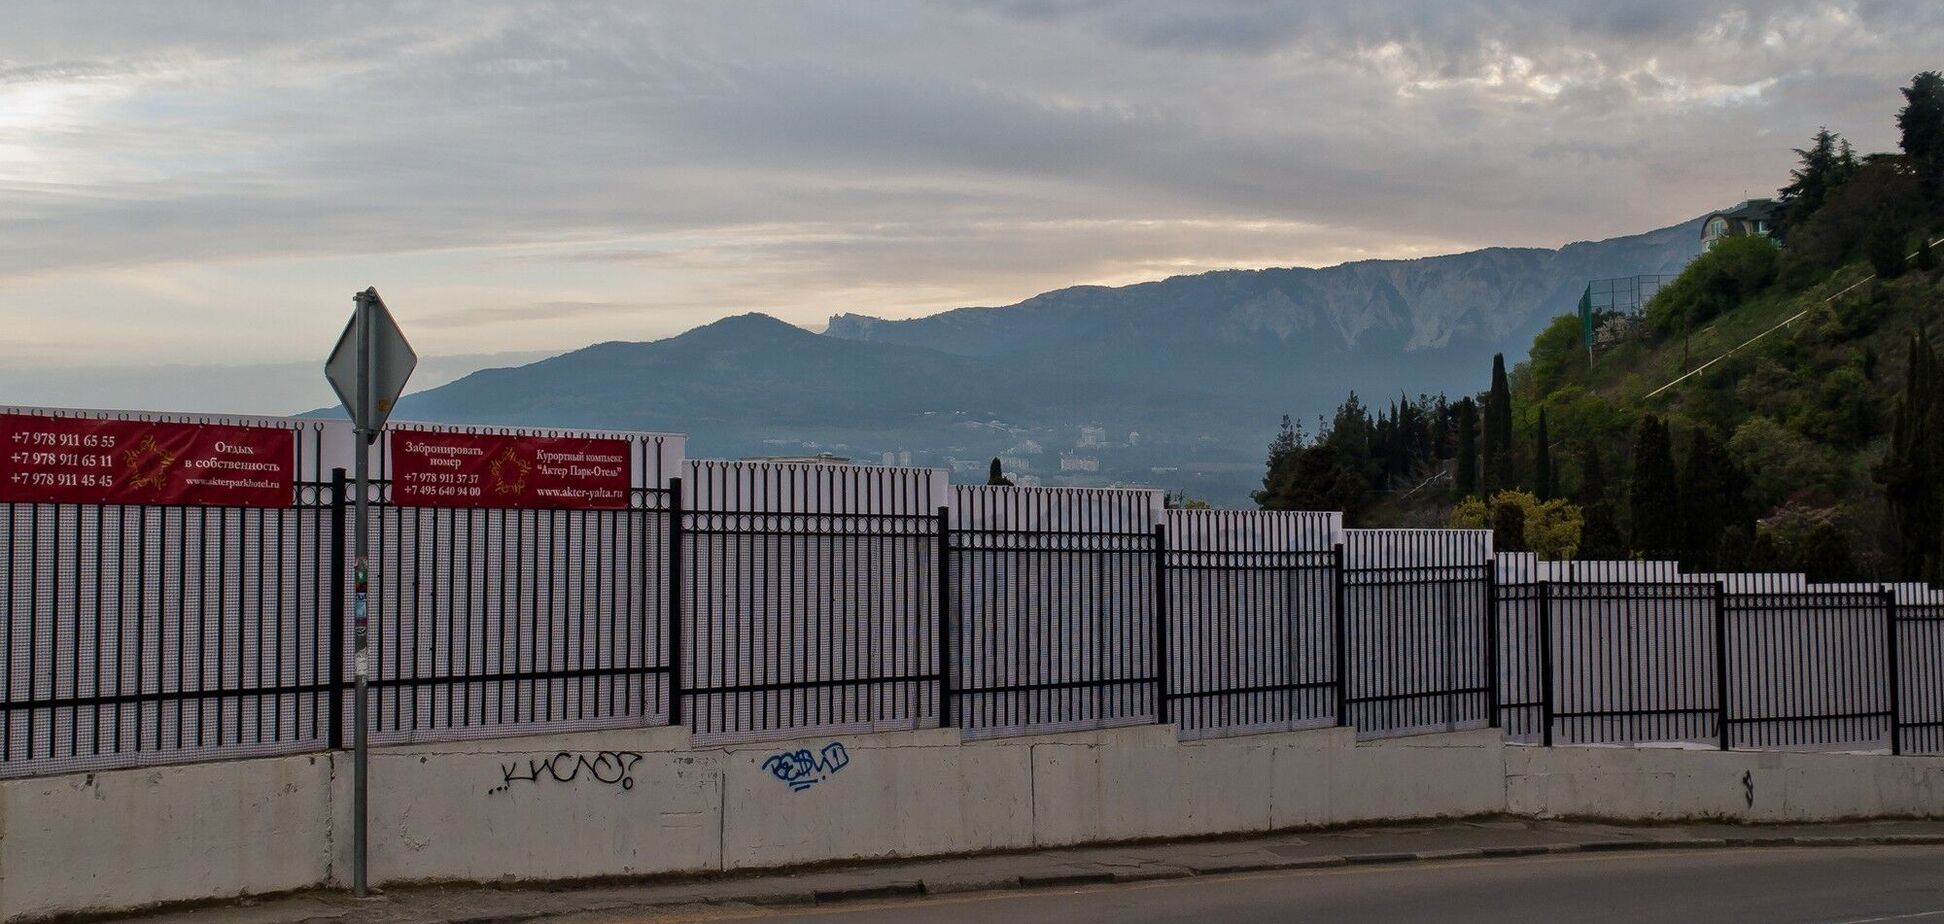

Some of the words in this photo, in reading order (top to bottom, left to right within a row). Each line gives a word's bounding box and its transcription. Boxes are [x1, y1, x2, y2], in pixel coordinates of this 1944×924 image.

[11, 431, 30, 444] +7
[33, 431, 56, 446] 978
[59, 433, 80, 447] 911
[83, 434, 98, 447] 65
[100, 435, 115, 448] 55
[214, 441, 254, 455] Отдых
[405, 441, 484, 458] Забронировать
[10, 451, 29, 465] +7
[32, 452, 56, 466] 978
[59, 453, 78, 466] 911
[81, 454, 97, 467] 65
[99, 455, 113, 467] 11
[184, 459, 193, 468] в
[195, 456, 280, 472] собственность
[430, 458, 462, 470] номер
[536, 449, 585, 464] Курортный
[585, 454, 623, 463] комплекс
[10, 472, 29, 485] +7
[32, 472, 55, 486] 978
[57, 473, 78, 486] 911
[80, 474, 96, 487] 45
[98, 474, 113, 487] 45
[185, 477, 280, 489] www.akterparkhotel.ru
[404, 472, 418, 482] +7
[419, 472, 437, 483] 978
[439, 473, 454, 484] 911
[456, 473, 468, 484] 37
[468, 474, 479, 484] 37
[404, 484, 418, 495] +7
[419, 485, 437, 496] 495
[438, 486, 456, 496] 640
[457, 486, 468, 496] 94
[469, 486, 481, 497] 00
[536, 486, 623, 501] www.akter-yalta.ru
